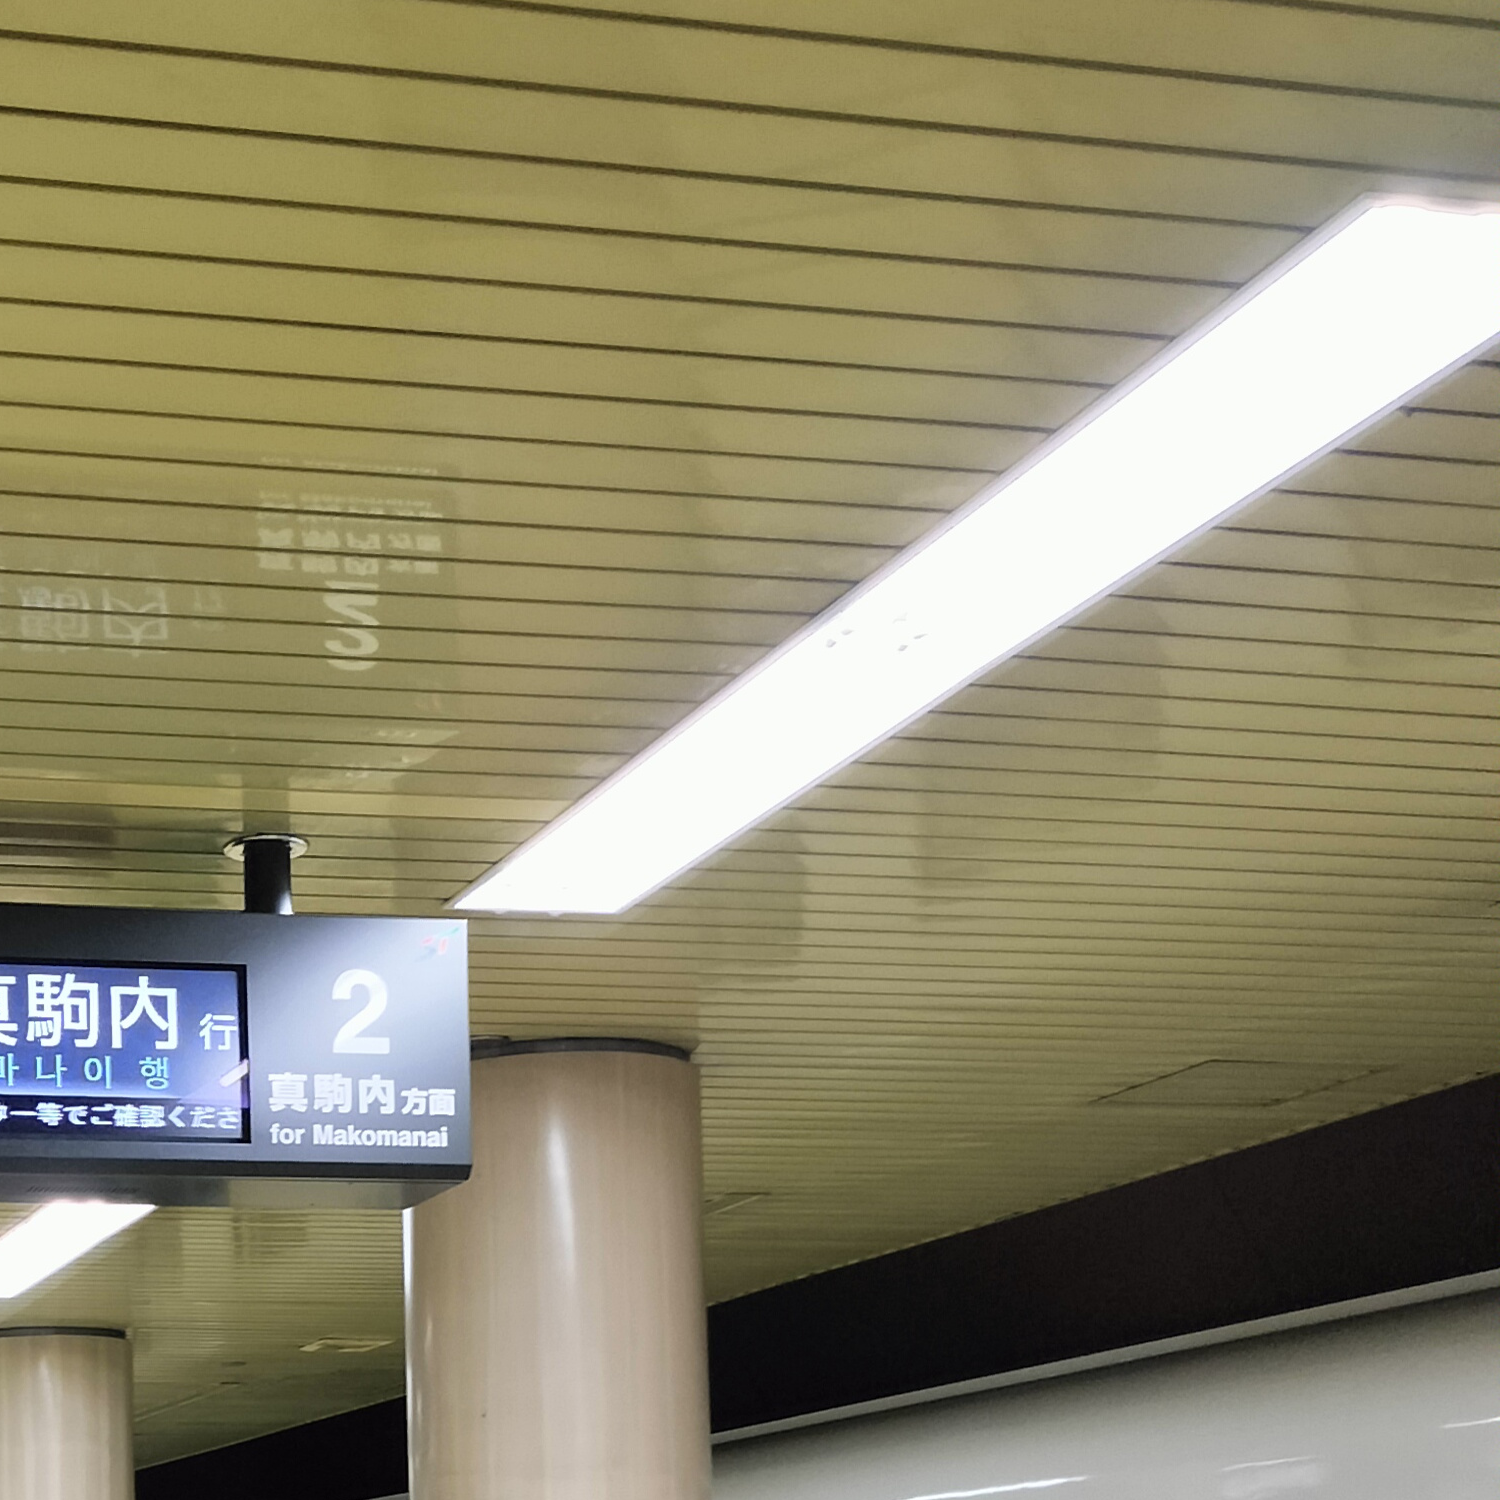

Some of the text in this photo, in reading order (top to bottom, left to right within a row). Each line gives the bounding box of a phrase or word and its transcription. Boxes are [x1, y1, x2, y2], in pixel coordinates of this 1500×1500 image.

[331, 969, 390, 1055] 2
[269, 1122, 449, 1148] for Makomanai
